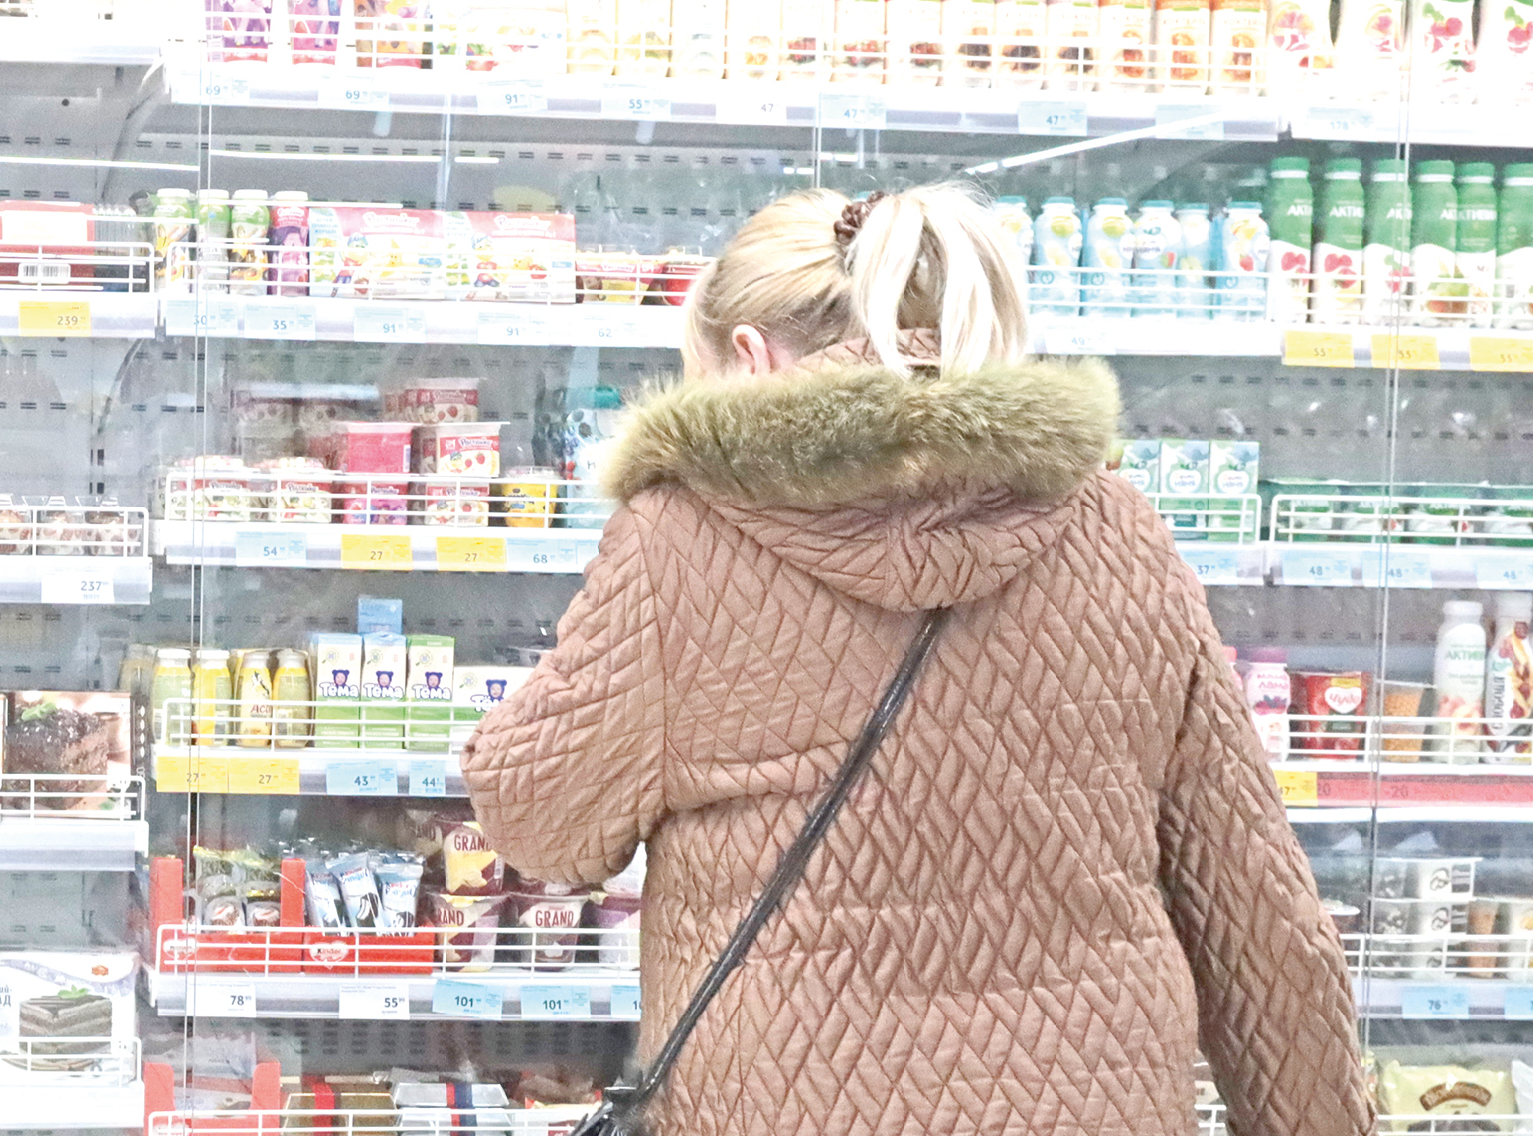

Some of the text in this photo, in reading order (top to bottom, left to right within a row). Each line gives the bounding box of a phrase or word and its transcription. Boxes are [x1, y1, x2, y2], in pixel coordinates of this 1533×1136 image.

[346, 90, 361, 100] 69
[505, 94, 518, 105] 91
[629, 98, 643, 109] 55
[1046, 115, 1059, 125] 47
[57, 315, 79, 326] 239
[272, 320, 287, 330] 35
[383, 323, 396, 333] 91
[506, 326, 519, 336] 91
[598, 328, 612, 338] 62
[263, 546, 278, 556] 54
[370, 551, 383, 561] 27
[464, 552, 478, 562] 27
[533, 553, 548, 564] 68
[1308, 566, 1324, 576] 48
[80, 580, 102, 592] 237
[258, 774, 272, 784] 27
[353, 775, 369, 786] 43
[453, 833, 489, 852] GRAN
[535, 910, 575, 927] GRAND
[230, 994, 244, 1006] 78
[383, 997, 398, 1008] 55
[454, 995, 474, 1008] 101
[542, 999, 562, 1010] 101
[1428, 1000, 1442, 1010] 76
